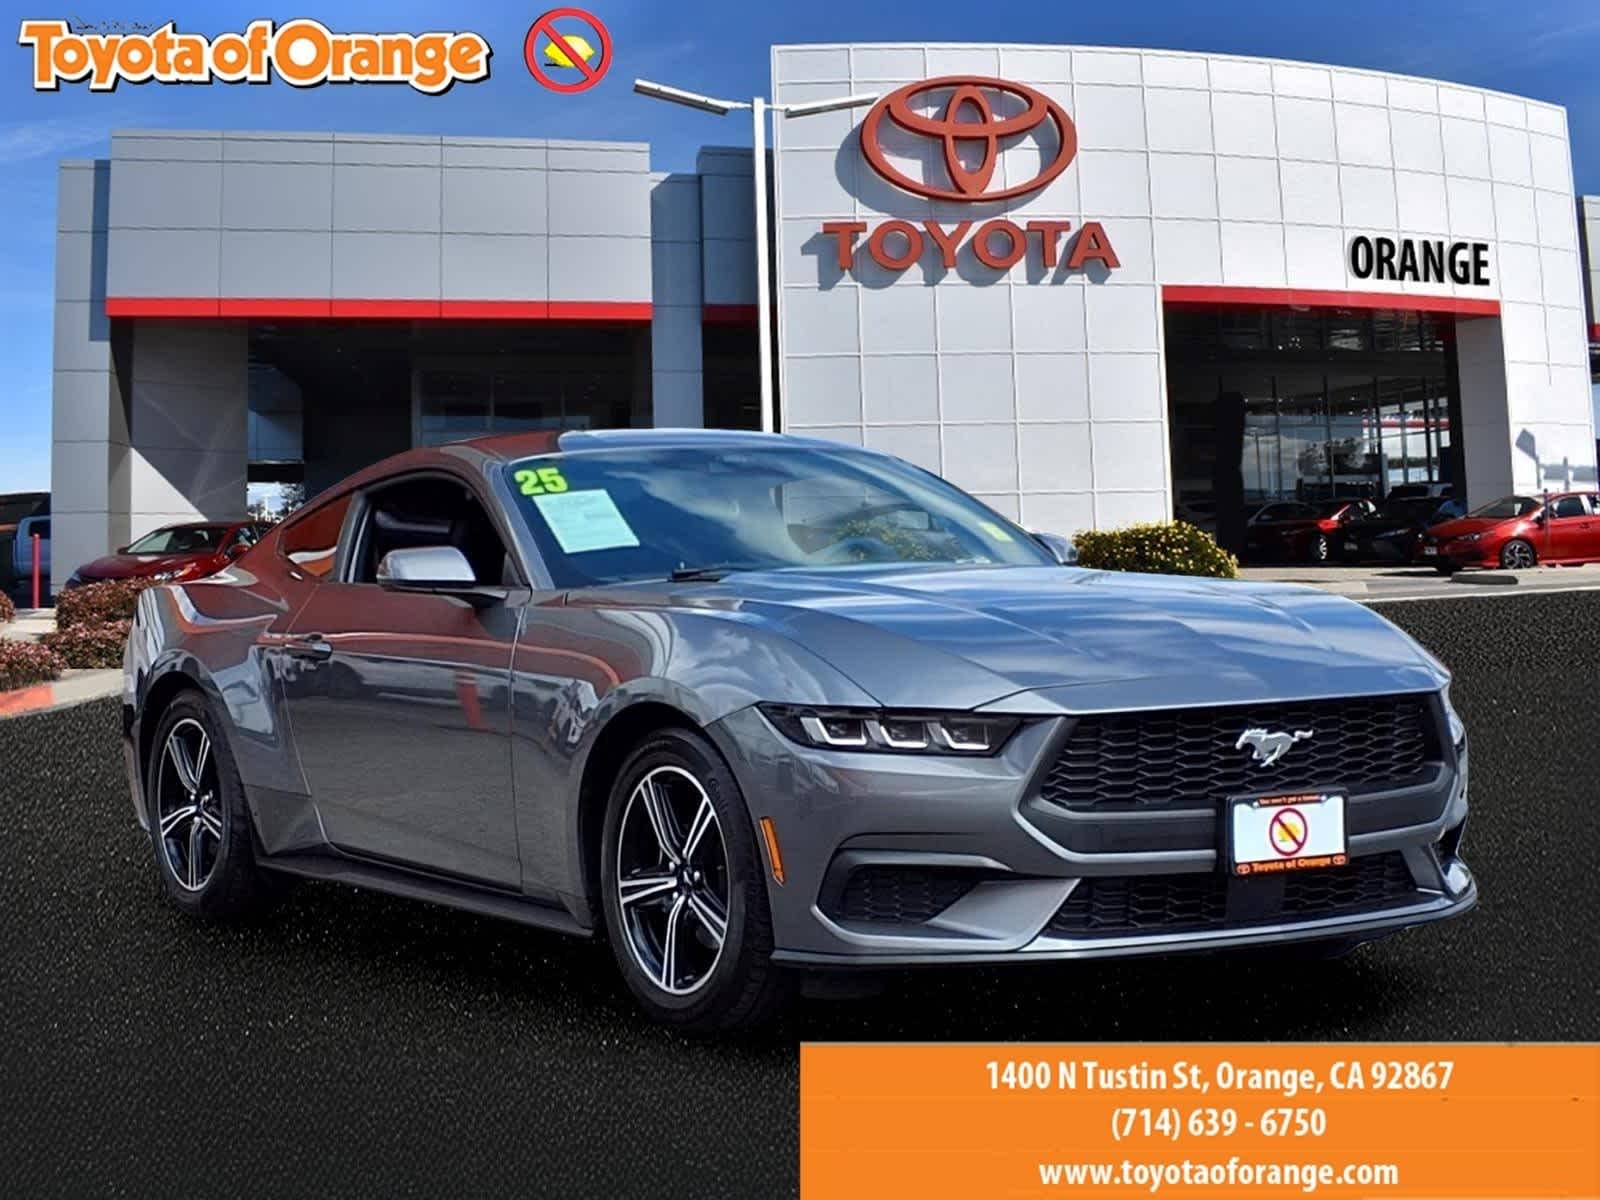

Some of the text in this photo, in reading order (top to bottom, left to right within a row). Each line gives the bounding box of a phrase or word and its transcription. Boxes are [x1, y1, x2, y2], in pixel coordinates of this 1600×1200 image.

[823, 219, 1120, 273] TOYOTA
[1349, 235, 1490, 286] ORANGE
[513, 467, 568, 495] 25
[1252, 857, 1331, 873] Toyota of Orange
